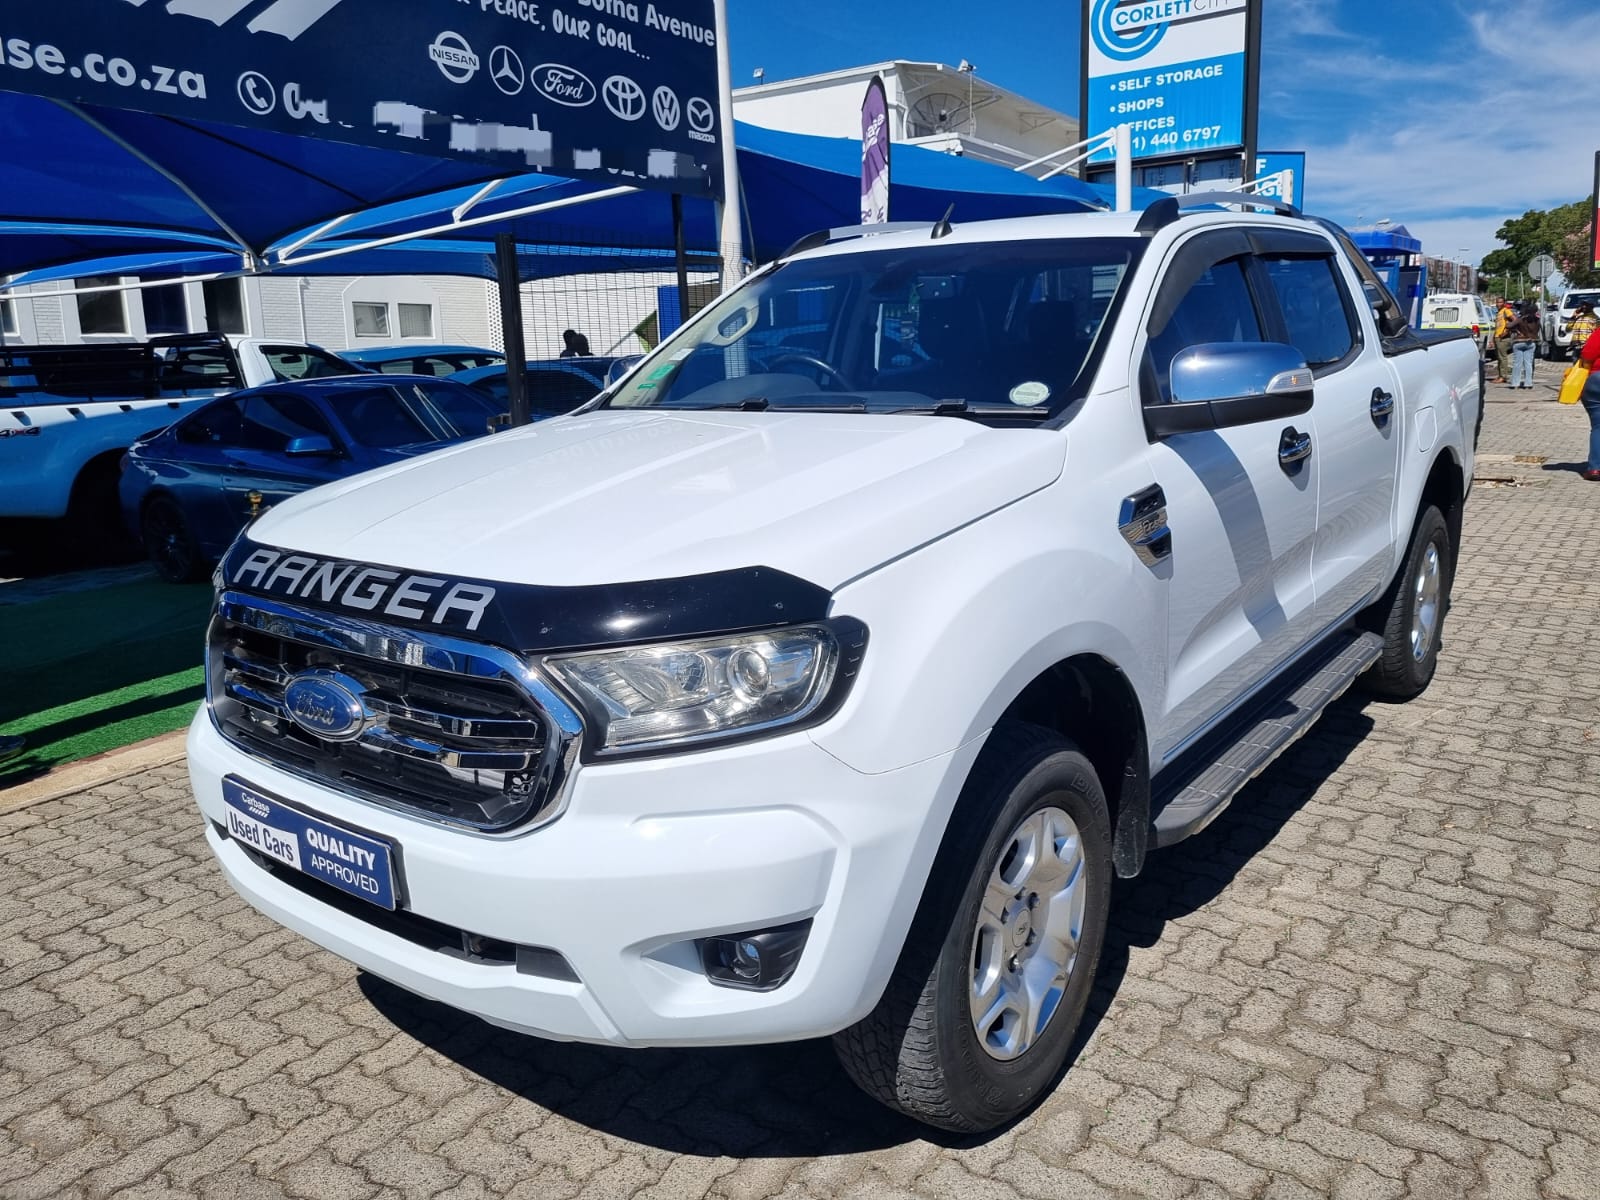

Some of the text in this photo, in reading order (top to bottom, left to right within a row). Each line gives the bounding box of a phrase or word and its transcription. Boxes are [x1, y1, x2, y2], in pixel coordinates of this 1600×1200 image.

[645, 3, 715, 47] Avenue
[1115, 0, 1191, 26] CORLETT
[552, 9, 590, 40] OUR
[596, 22, 651, 60] GOAL...
[0, 36, 208, 100] se.co.za
[431, 47, 477, 67] NISSAN
[544, 69, 585, 100] Ford
[1118, 64, 1224, 92] SELF STORAGE
[1117, 96, 1164, 114] SHOPS
[687, 129, 716, 144] mazda
[1150, 131, 1178, 147] 440
[1182, 124, 1221, 143] 6797
[232, 549, 497, 631] RANGER
[241, 791, 271, 815] Carbase
[229, 810, 295, 863] Used Cars
[305, 826, 376, 872] QUALITY
[310, 852, 380, 896] APPROVED
